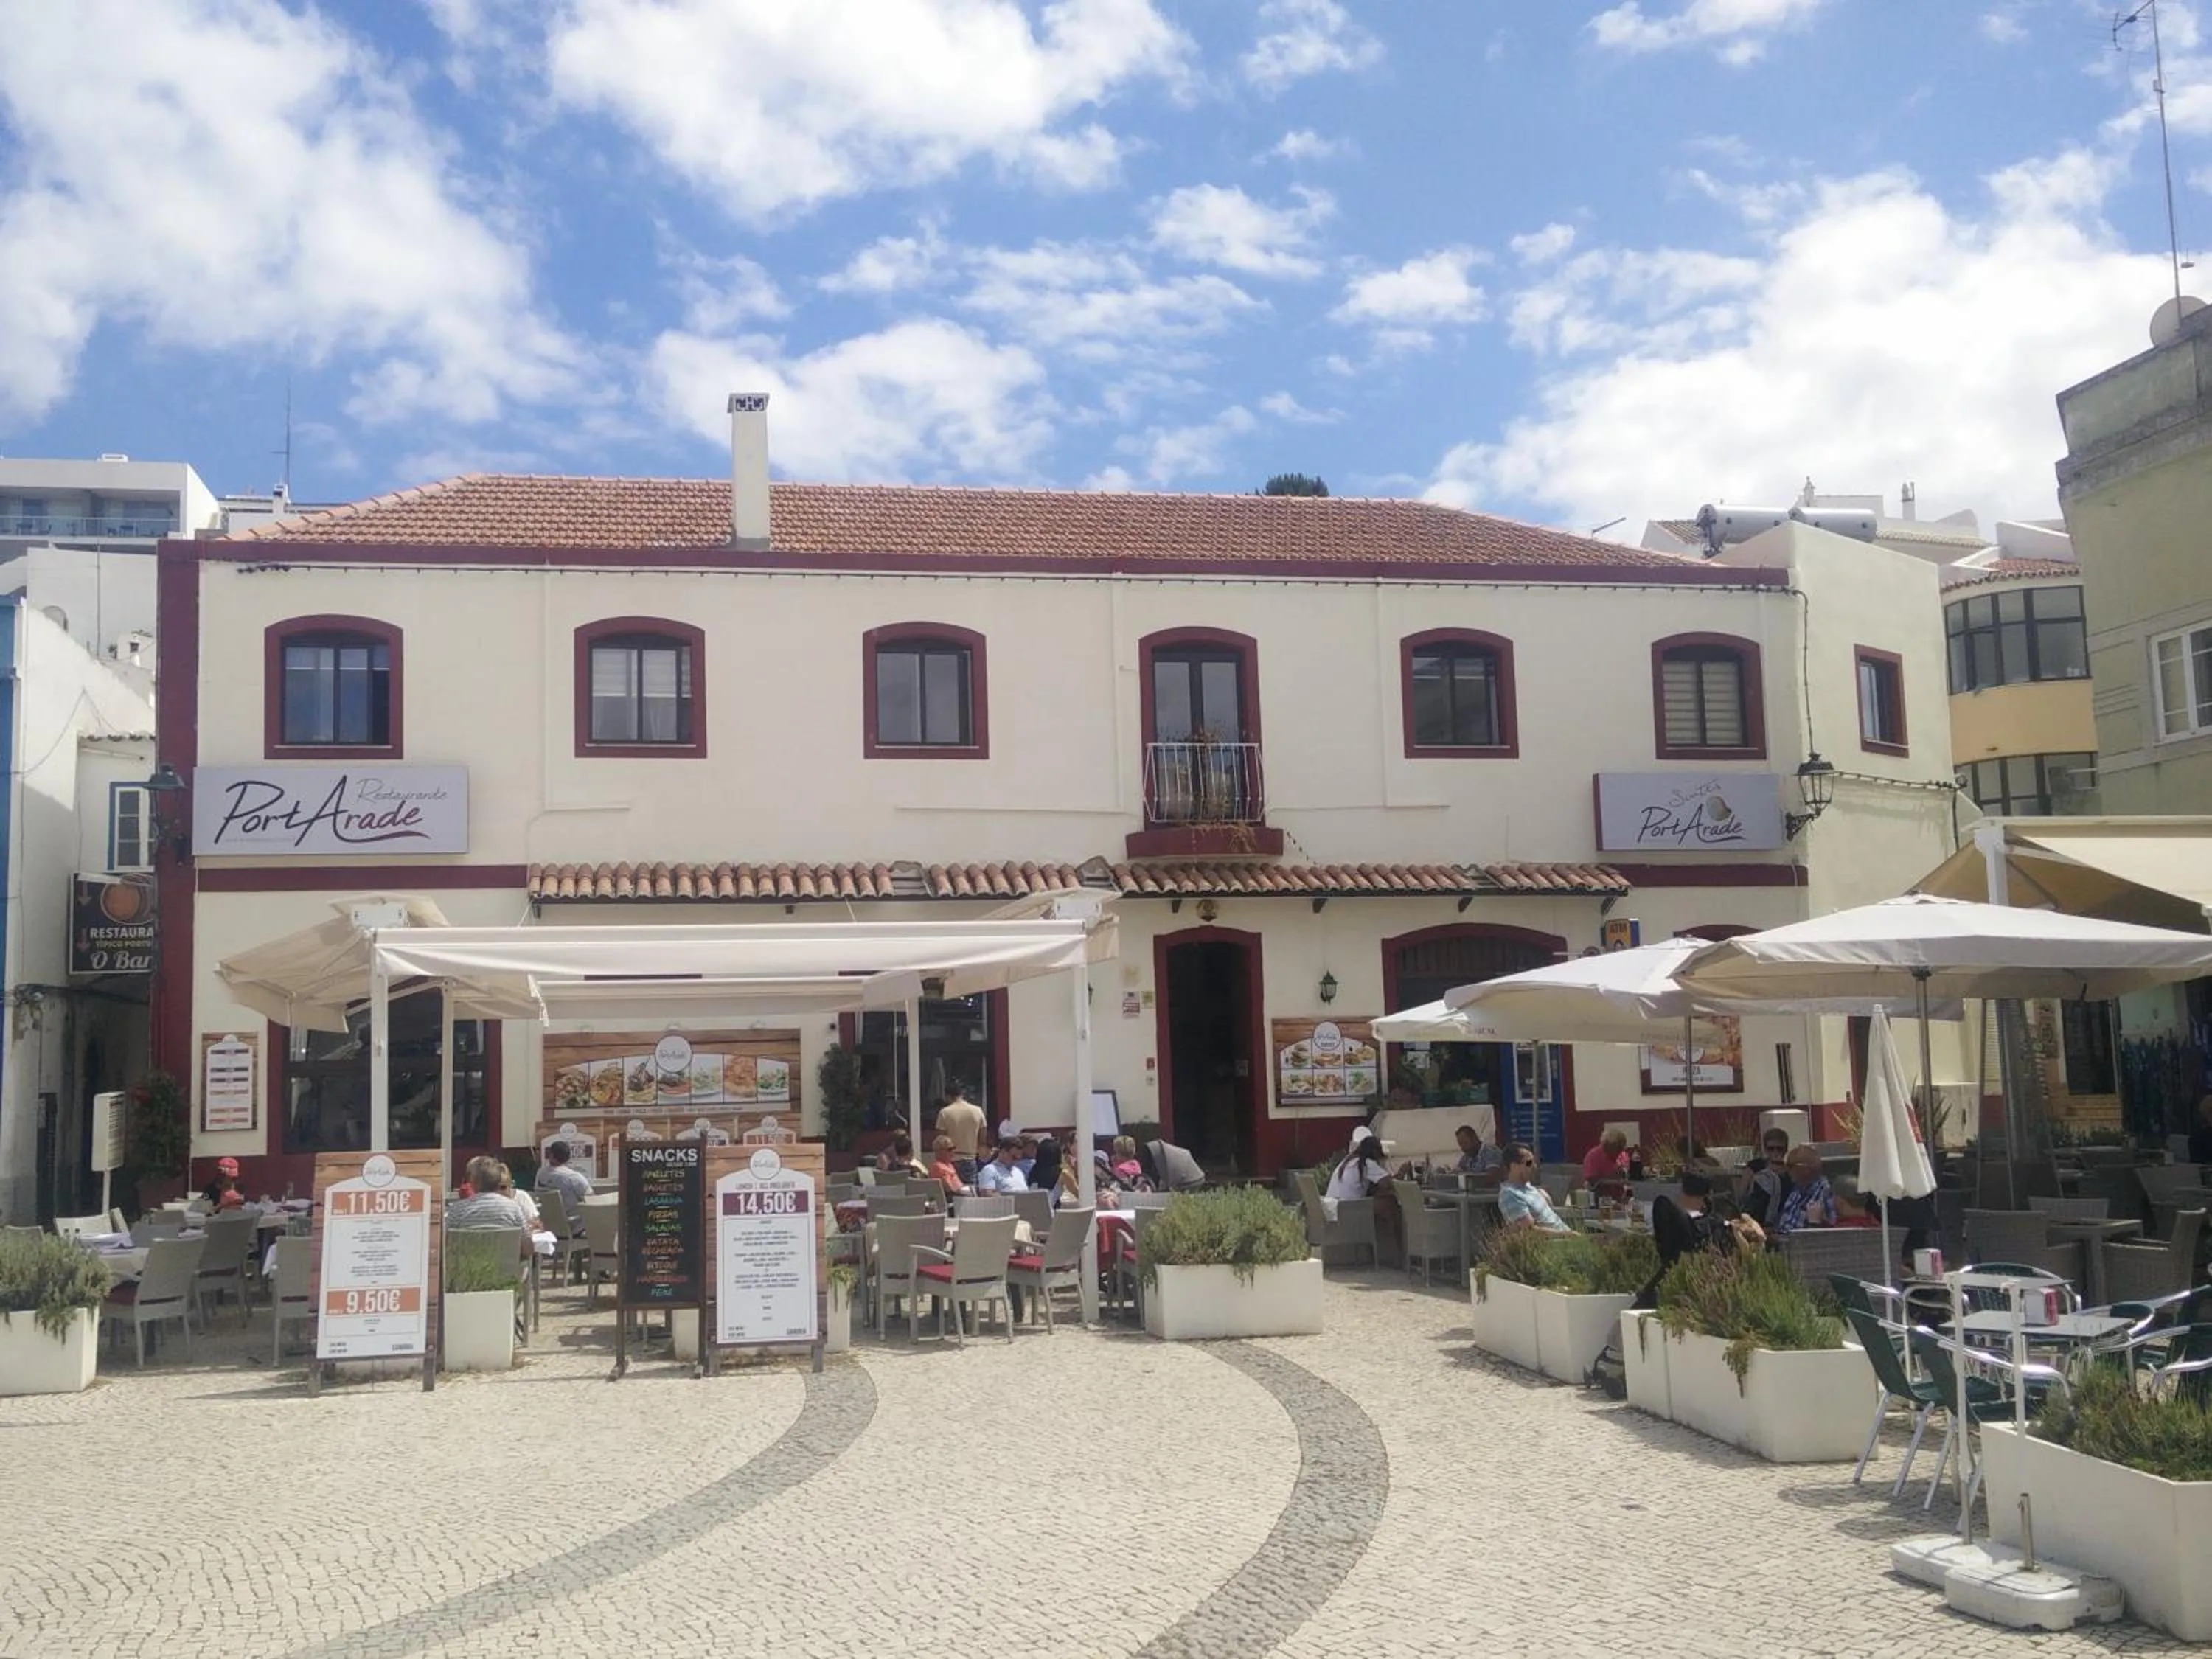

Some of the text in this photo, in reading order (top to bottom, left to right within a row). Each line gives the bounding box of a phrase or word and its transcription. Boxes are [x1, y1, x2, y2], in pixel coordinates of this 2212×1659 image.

[356, 778, 448, 803] Restaurante
[1610, 922, 1627, 933] ATM
[630, 1148, 698, 1163] SNACKS
[348, 1191, 411, 1214] 11.50€
[737, 1191, 796, 1215] 14.50€
[346, 1290, 401, 1315] 9.50€
